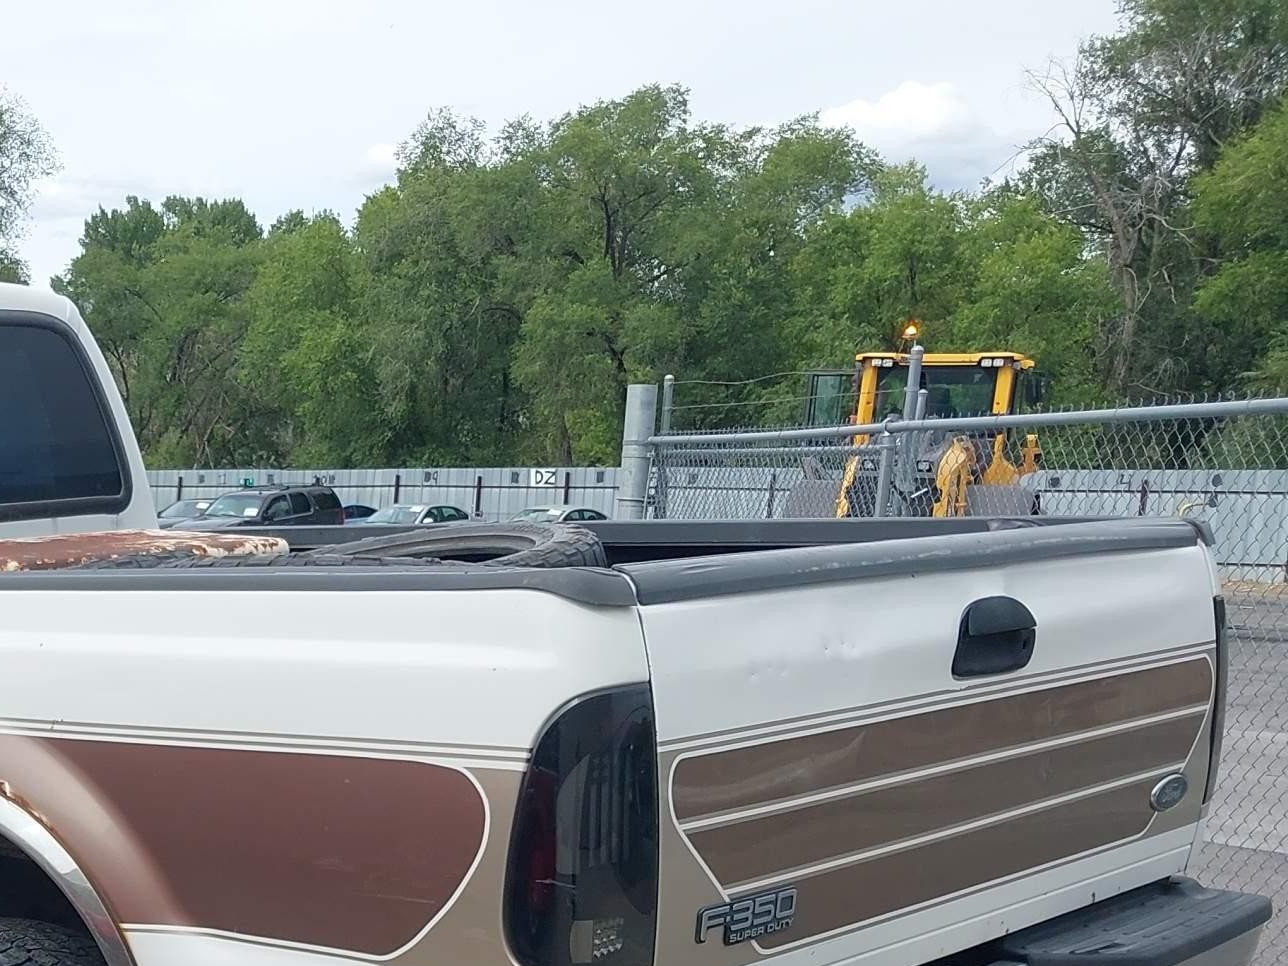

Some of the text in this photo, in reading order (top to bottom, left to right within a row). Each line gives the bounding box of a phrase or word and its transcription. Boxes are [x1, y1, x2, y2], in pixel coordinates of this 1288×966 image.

[535, 469, 556, 485] DZ
[729, 918, 794, 943] SUPER DUTY
